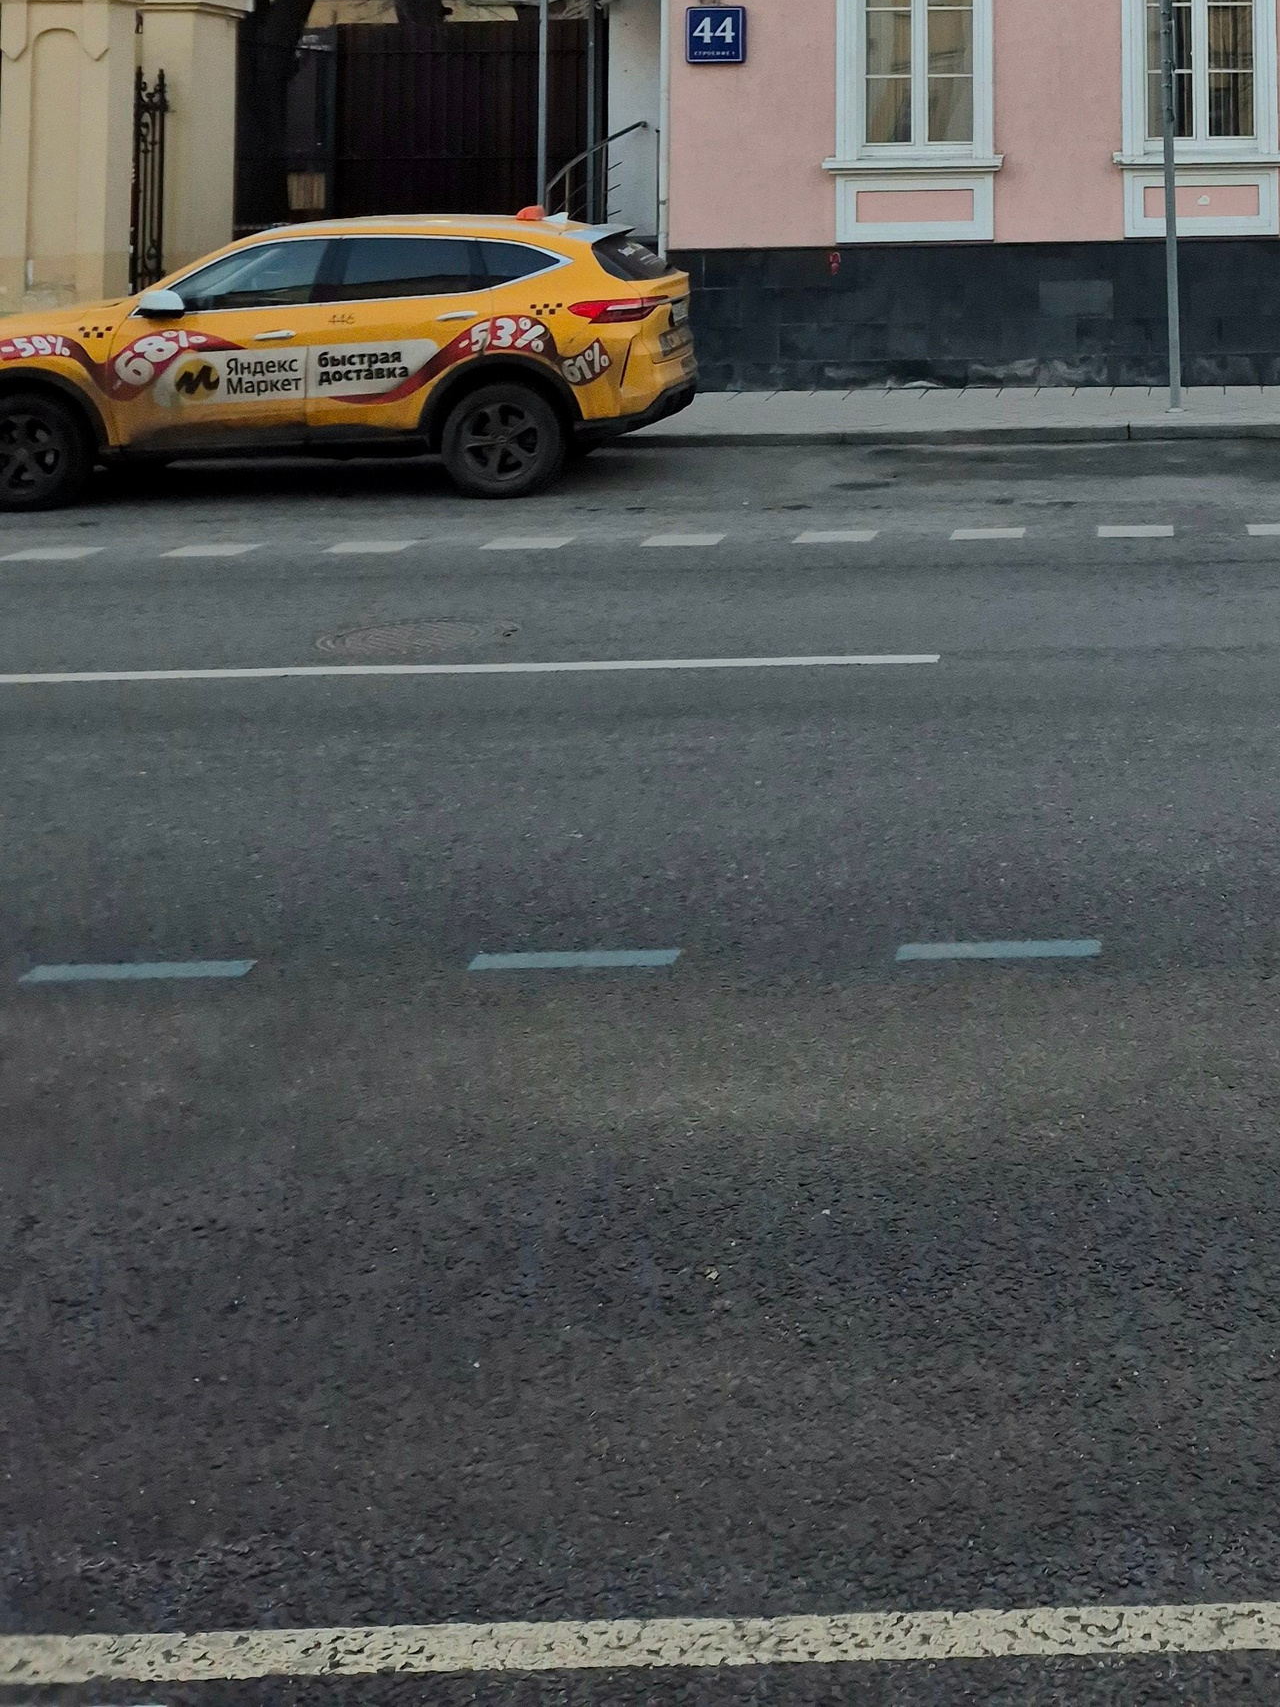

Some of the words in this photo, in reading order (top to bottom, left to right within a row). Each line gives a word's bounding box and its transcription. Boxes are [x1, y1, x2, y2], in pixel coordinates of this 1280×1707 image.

[692, 16, 735, 44] 44
[459, 316, 546, 354] -53%
[0, 336, 72, 358] -59%
[226, 357, 300, 377] Яндекс
[317, 350, 403, 369] быстрая
[226, 377, 302, 396] Маркет
[317, 365, 410, 387] доставка
